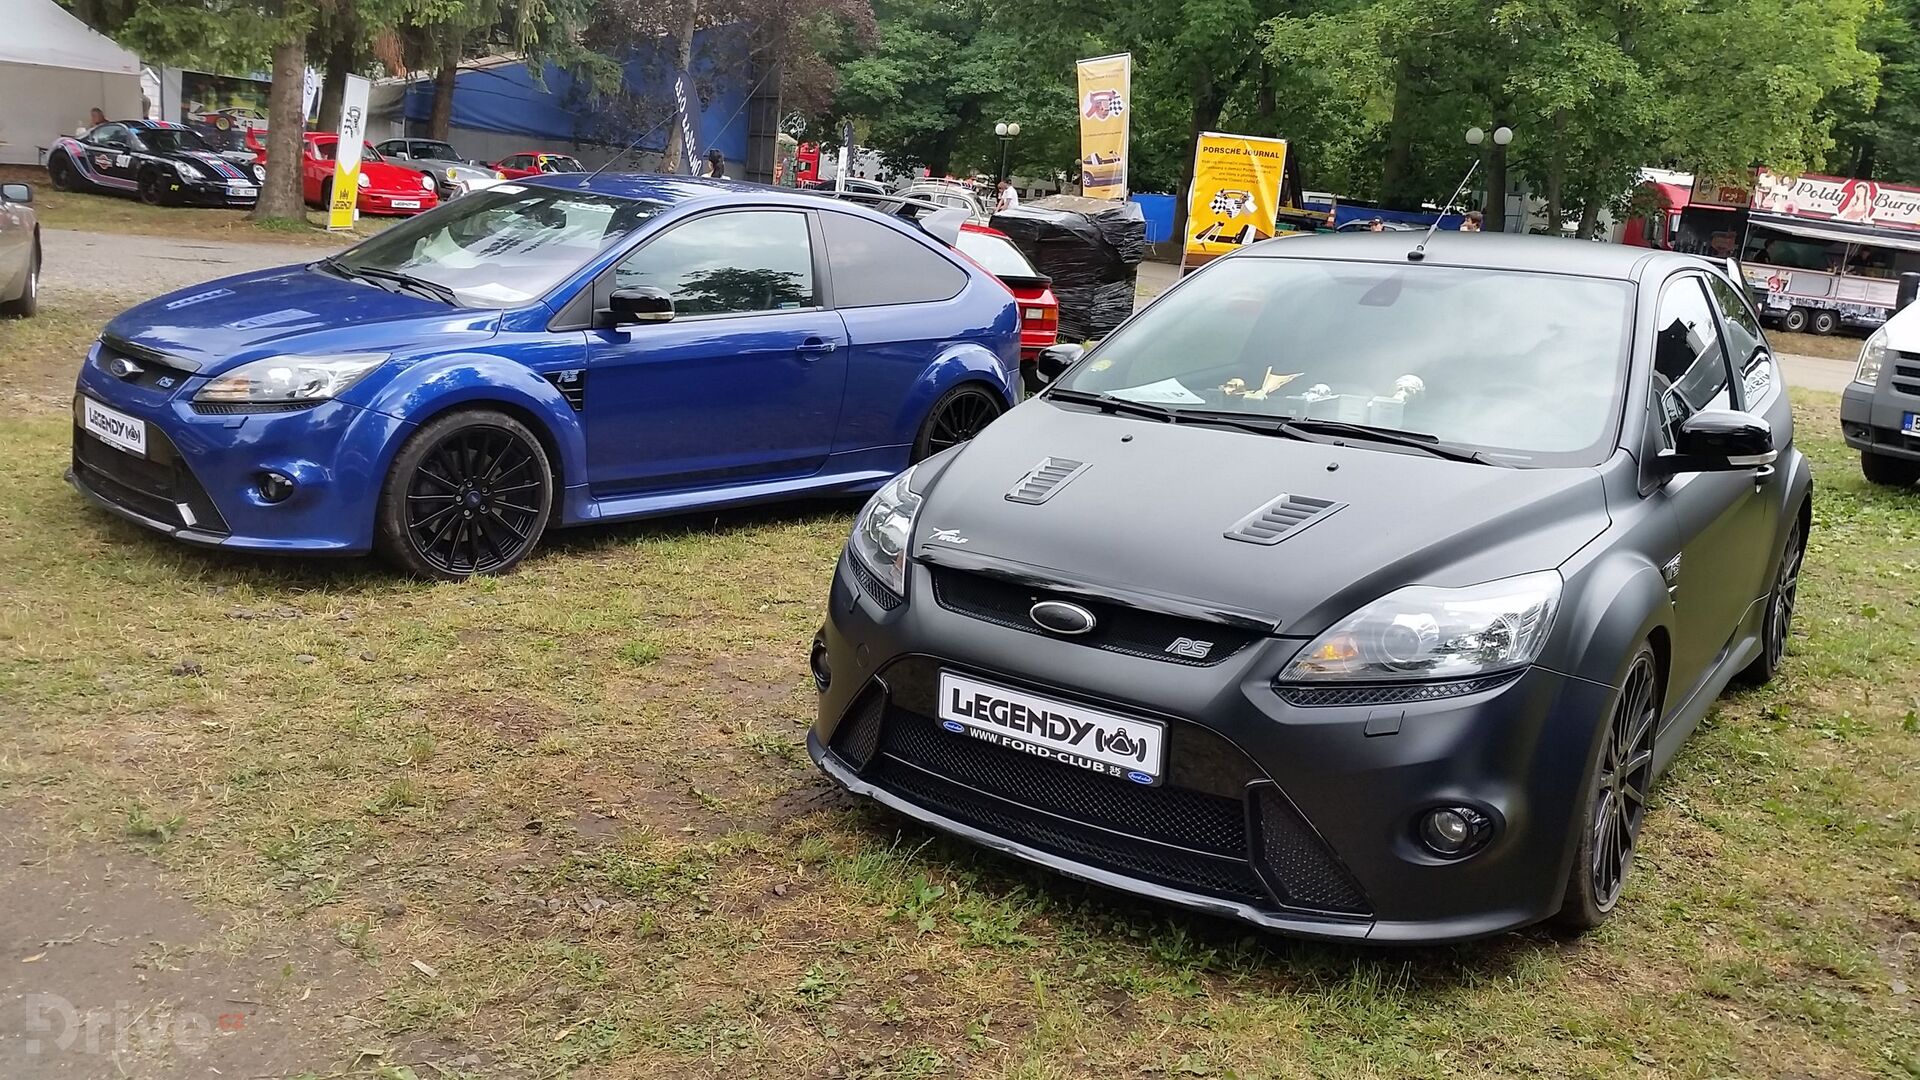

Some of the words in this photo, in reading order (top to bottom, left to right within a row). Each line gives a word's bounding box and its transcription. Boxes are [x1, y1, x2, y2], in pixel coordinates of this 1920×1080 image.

[1203, 146, 1241, 155] PORSCHE
[1243, 148, 1280, 159] JOURNAL
[1796, 181, 1847, 206] Poldy
[156, 376, 175, 387] RS
[558, 371, 578, 382] RS
[89, 406, 126, 437] LEGENDY
[1164, 637, 1213, 659] RS
[951, 688, 1095, 746] LEGENDY
